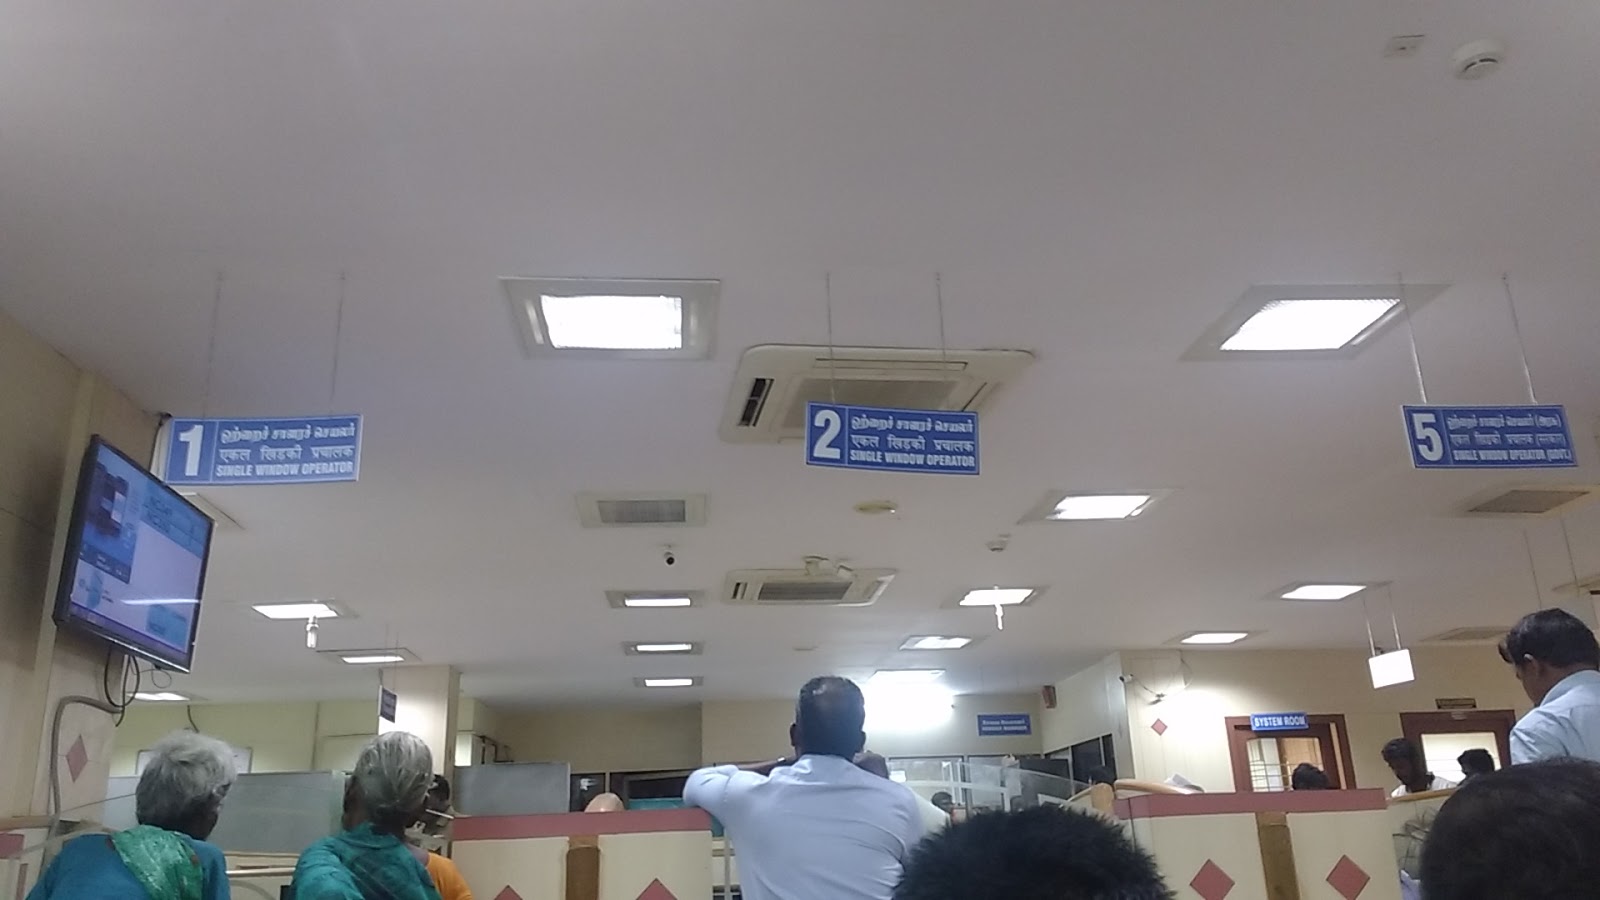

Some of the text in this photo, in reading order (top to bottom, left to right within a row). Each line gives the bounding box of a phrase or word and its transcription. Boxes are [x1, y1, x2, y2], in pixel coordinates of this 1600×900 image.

[813, 409, 841, 459] 2
[851, 434, 879, 449] एकल
[1412, 413, 1444, 461] 5
[179, 424, 204, 477] 1
[218, 448, 251, 463] एकल
[850, 449, 976, 467] SINGLE WINDOW OPERATOR
[1452, 449, 1478, 461] SINGLE
[1479, 449, 1508, 461] WINDOW
[1509, 449, 1546, 461] OPERATOR
[216, 461, 354, 477] SINGLE WINDOW OPERATOR
[1254, 715, 1306, 727] SYSTEM ROOM
